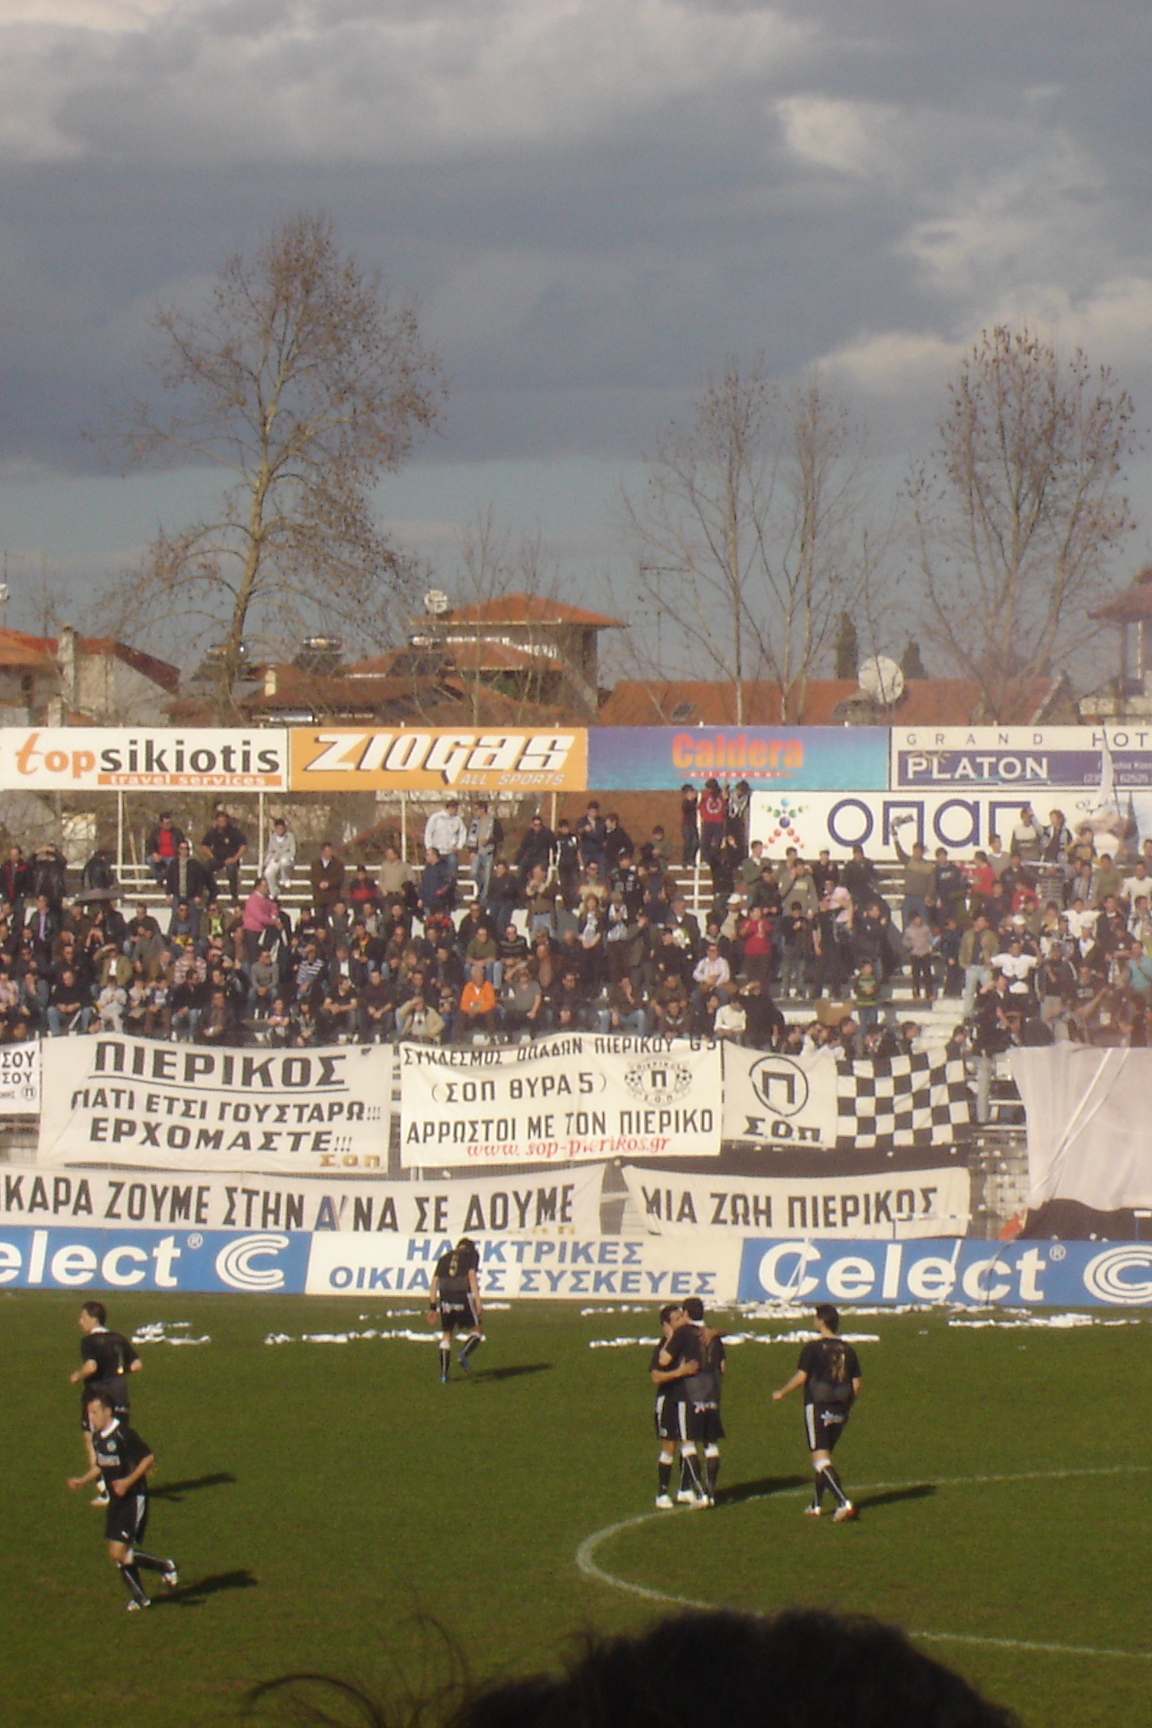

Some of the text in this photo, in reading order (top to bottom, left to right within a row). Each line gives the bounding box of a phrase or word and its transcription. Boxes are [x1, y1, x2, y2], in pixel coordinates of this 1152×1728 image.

[672, 733, 804, 769] Caldera
[907, 732, 1044, 745] GRAND
[111, 775, 266, 787] travel services
[460, 773, 564, 786] ALL SPORTS
[906, 754, 1049, 779] PLATON
[94, 1040, 347, 1088] ΠΙΕΡΙΚΟΣ
[404, 1048, 503, 1066] ΣΥΝΔΕΣΜΟΣ
[516, 1037, 583, 1063] ΟΠΑΔΩΝ
[595, 1036, 675, 1055] ΠΙΕΡΙΚΟΥ
[71, 1088, 135, 1111] ΓΙΑΤΙ
[146, 1093, 207, 1120] ΕΤΣΙ
[89, 1116, 353, 1153] ΕΡΧΟΜΑΣΤΕ!!!
[406, 1108, 714, 1145] ΑΡΡΩΣΤΟΙ ΜΕ ΤΟΝ ΠΙΕΡΙΚΟ
[104, 1180, 211, 1226] ΖΟΥΜΕ
[222, 1186, 305, 1231] ΣΤΗΝ
[353, 1195, 399, 1232] ΝΑ
[414, 1195, 449, 1232] ΣΕ
[463, 1184, 576, 1233] ΔΟΥΜΕ
[641, 1186, 939, 1228] ΜΙΑ ΖΩΗ ΠΙΕΡΙΚΟΣ
[406, 1238, 645, 1265] ΗΛΚΤΡΙΚΕΣ
[329, 1266, 717, 1295] ΟΙΚΙΑΣ ΣΥΣΚΕΥΕΣ
[757, 1240, 1047, 1302] Celect
